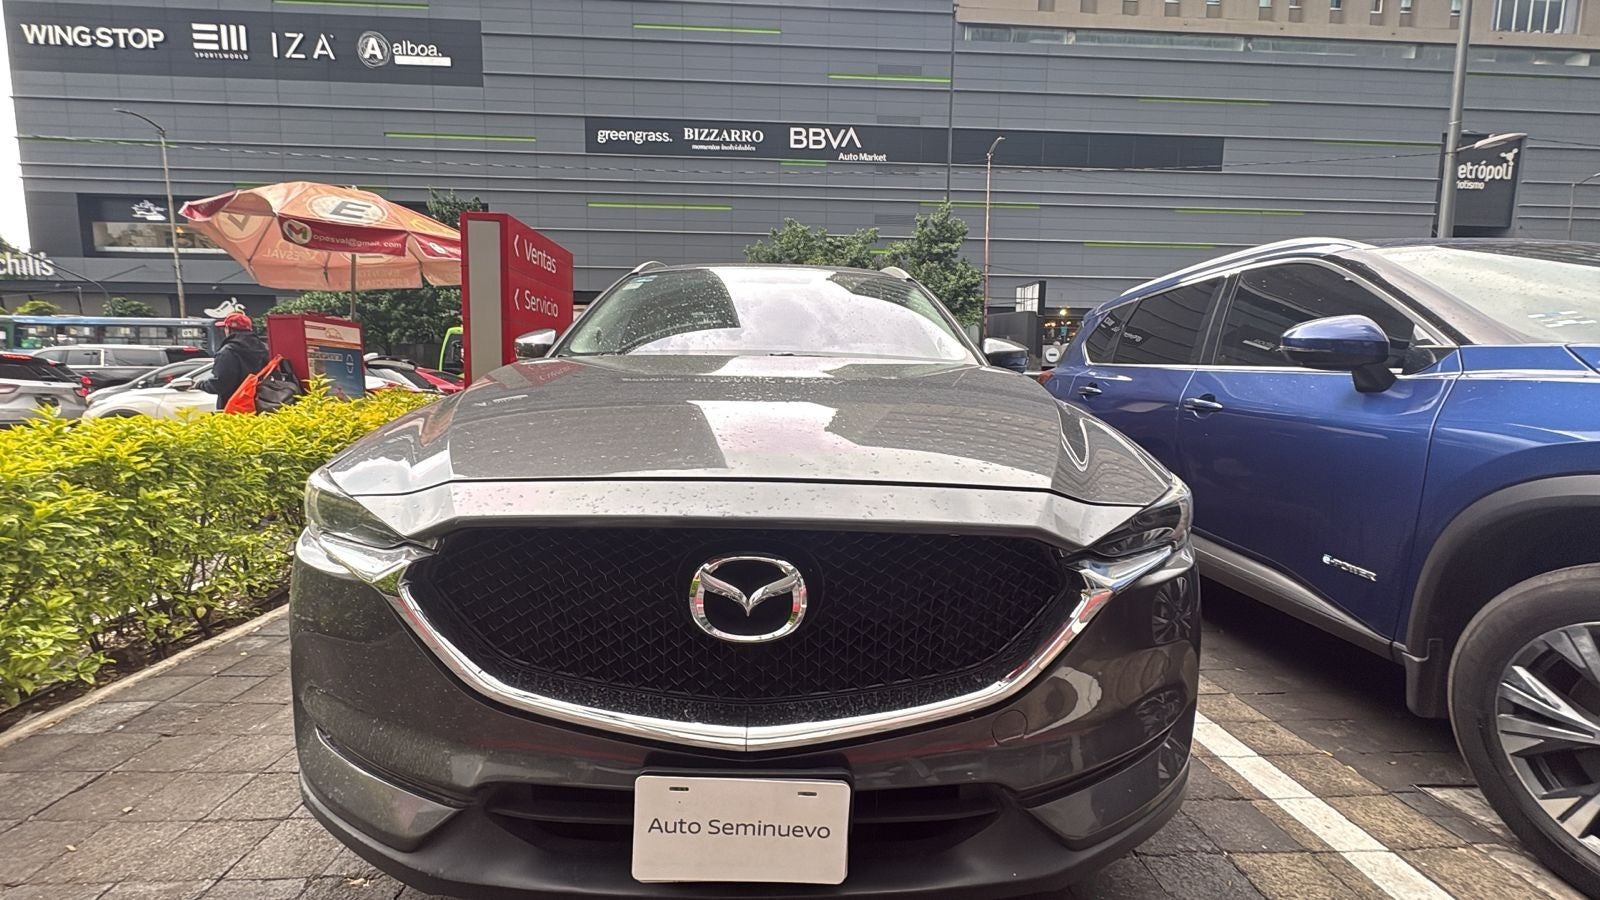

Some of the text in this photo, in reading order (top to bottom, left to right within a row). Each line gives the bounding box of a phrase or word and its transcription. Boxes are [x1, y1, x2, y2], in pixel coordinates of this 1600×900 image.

[271, 31, 336, 60] IZA
[683, 127, 764, 143] BIZZARRO
[789, 126, 862, 150] BBVA
[838, 152, 887, 162] Auto Market
[524, 239, 557, 274] Ventas
[524, 290, 559, 318] Servicio
[648, 817, 831, 839] Auto Seminuevo
